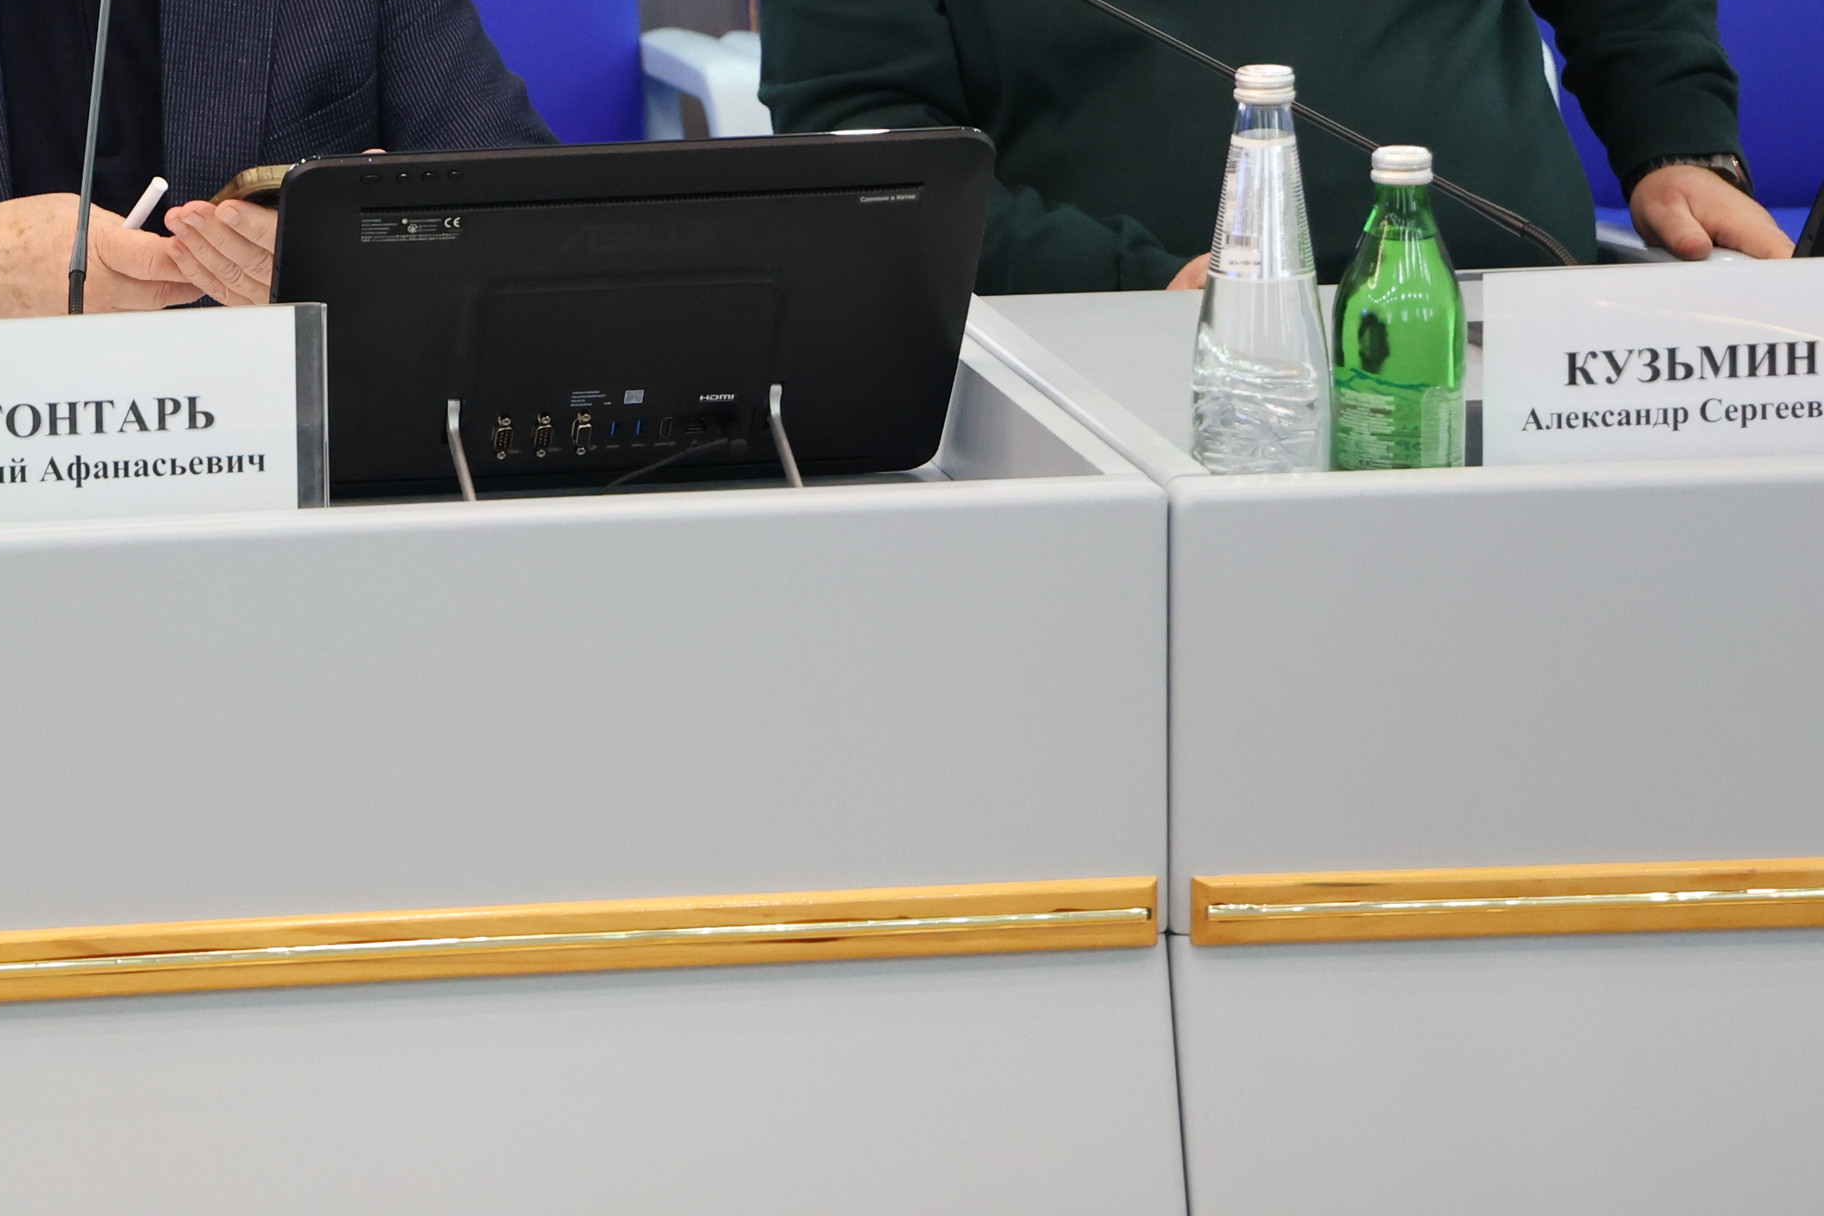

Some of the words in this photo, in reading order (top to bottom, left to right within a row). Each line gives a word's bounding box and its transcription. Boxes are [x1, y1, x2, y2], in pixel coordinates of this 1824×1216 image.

[1564, 340, 1819, 386] КУЗЬМИН
[699, 393, 735, 401] HDMI
[1521, 405, 1690, 432] Александр
[39, 453, 266, 489] Афанасьевич
